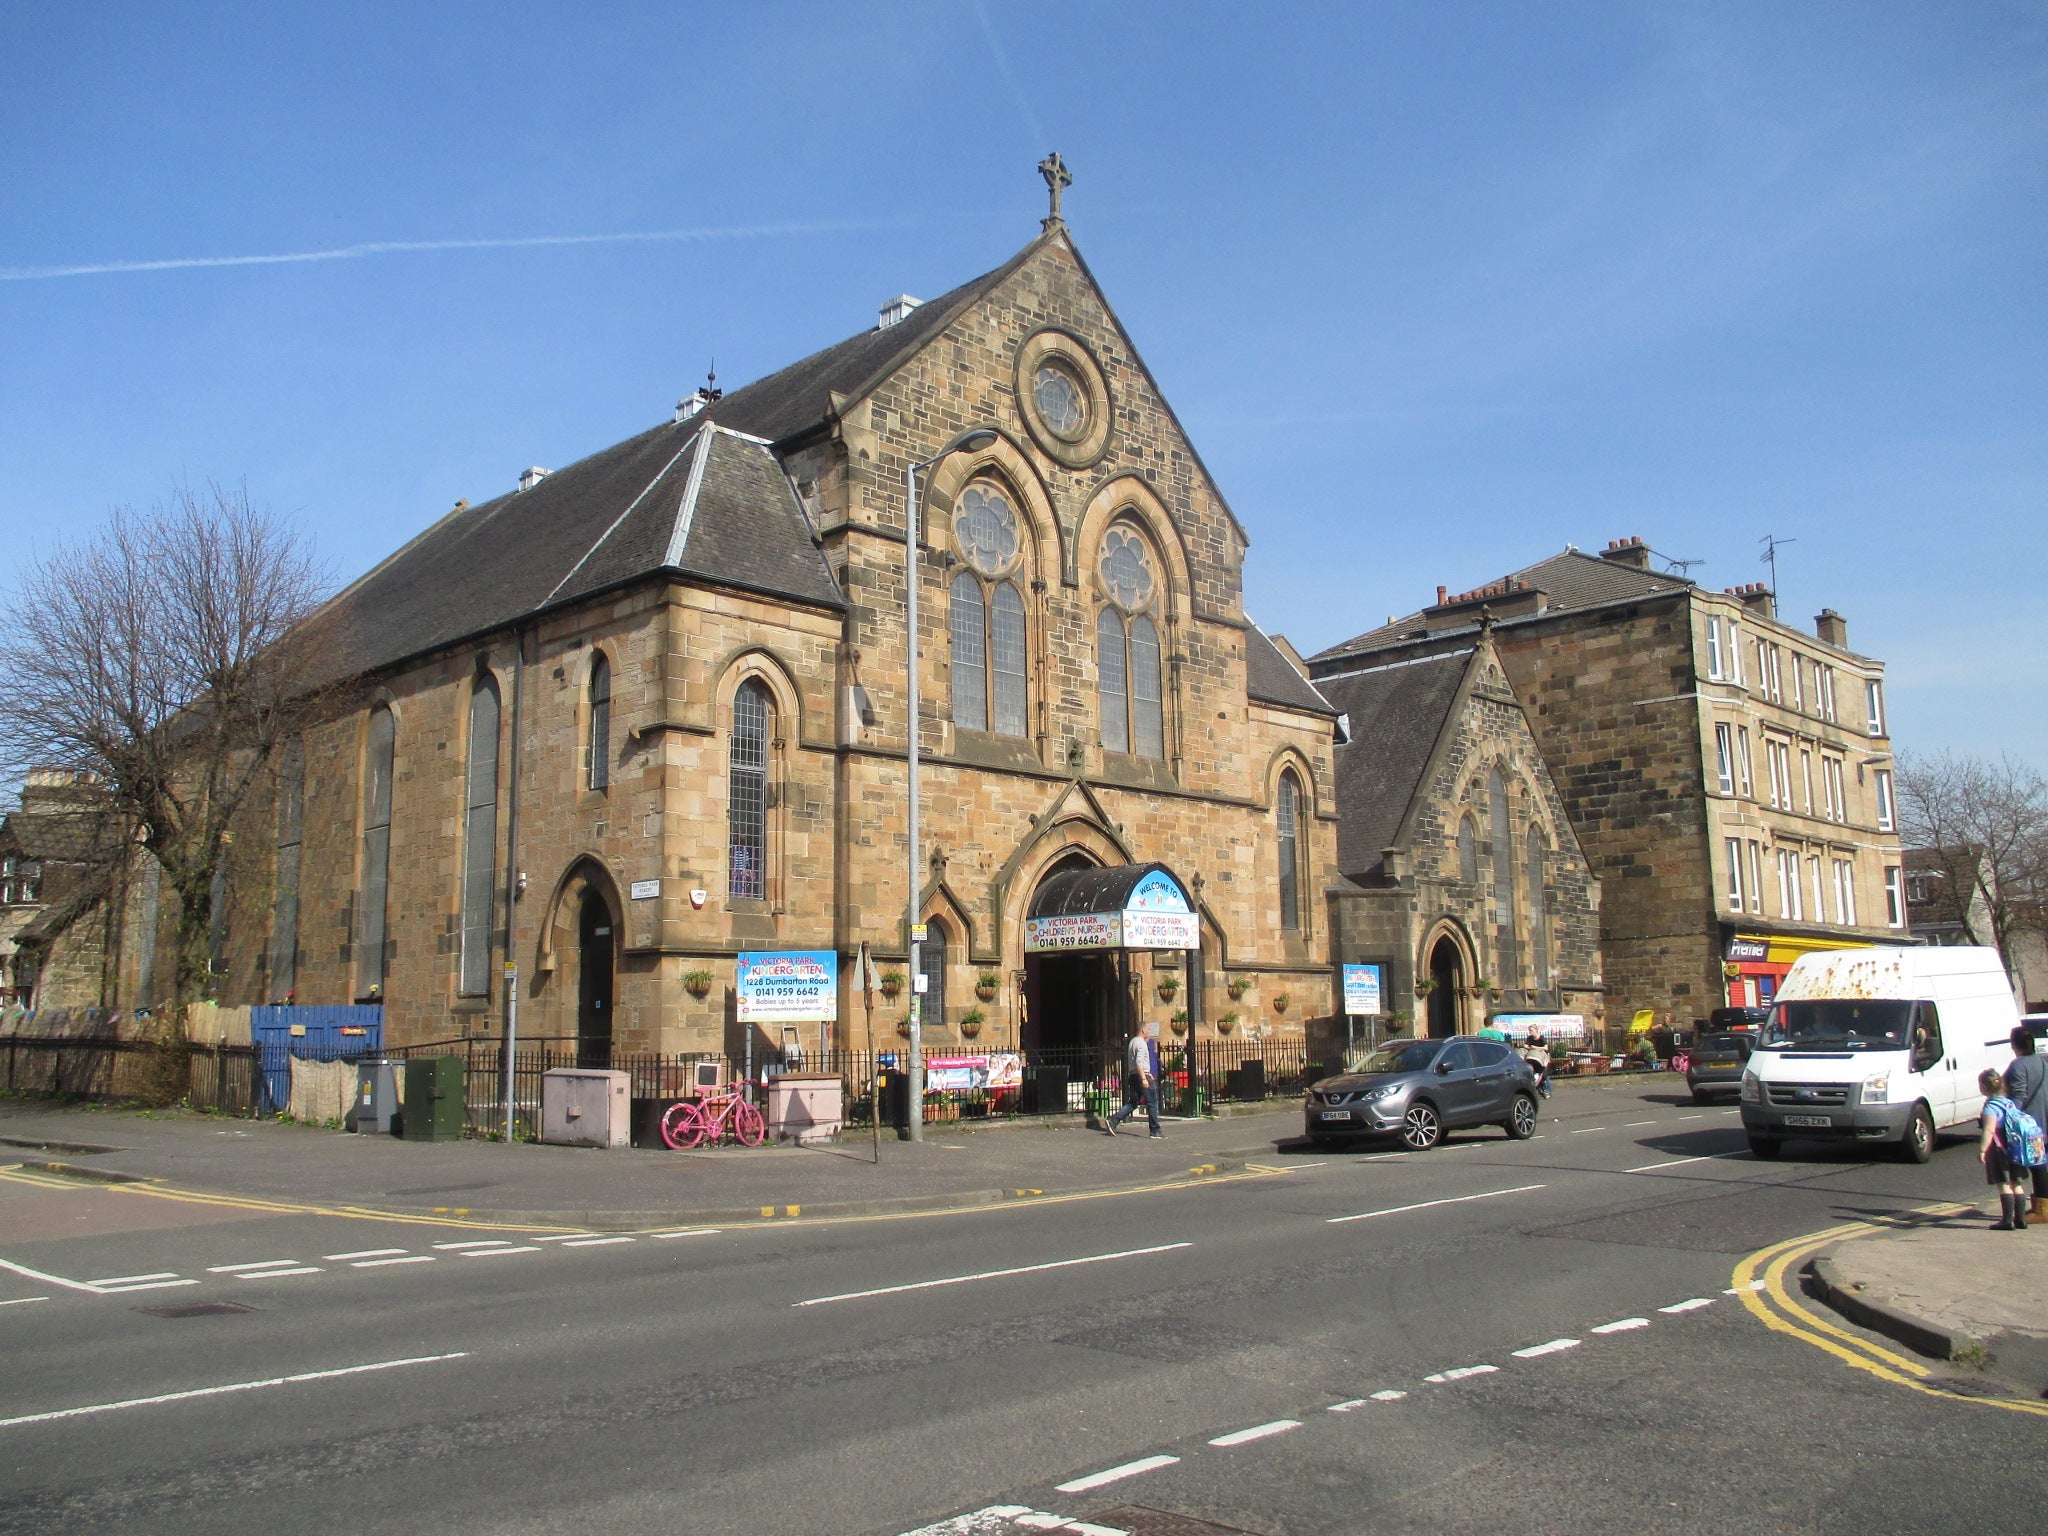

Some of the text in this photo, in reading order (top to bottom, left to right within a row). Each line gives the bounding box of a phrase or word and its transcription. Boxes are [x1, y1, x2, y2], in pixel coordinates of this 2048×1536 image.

[1140, 882, 1177, 898] WELCOME TO
[1048, 916, 1097, 926] VICTORIA PARK
[1039, 924, 1108, 937] CHILDREN'S NURSERY
[1135, 925, 1188, 936] KINDERGARTEN
[1040, 935, 1099, 947] 0141 959 6642
[1731, 941, 1765, 957] Premier
[752, 966, 822, 975] KINDERGARTEN
[756, 987, 818, 996] 0141 959 6642
